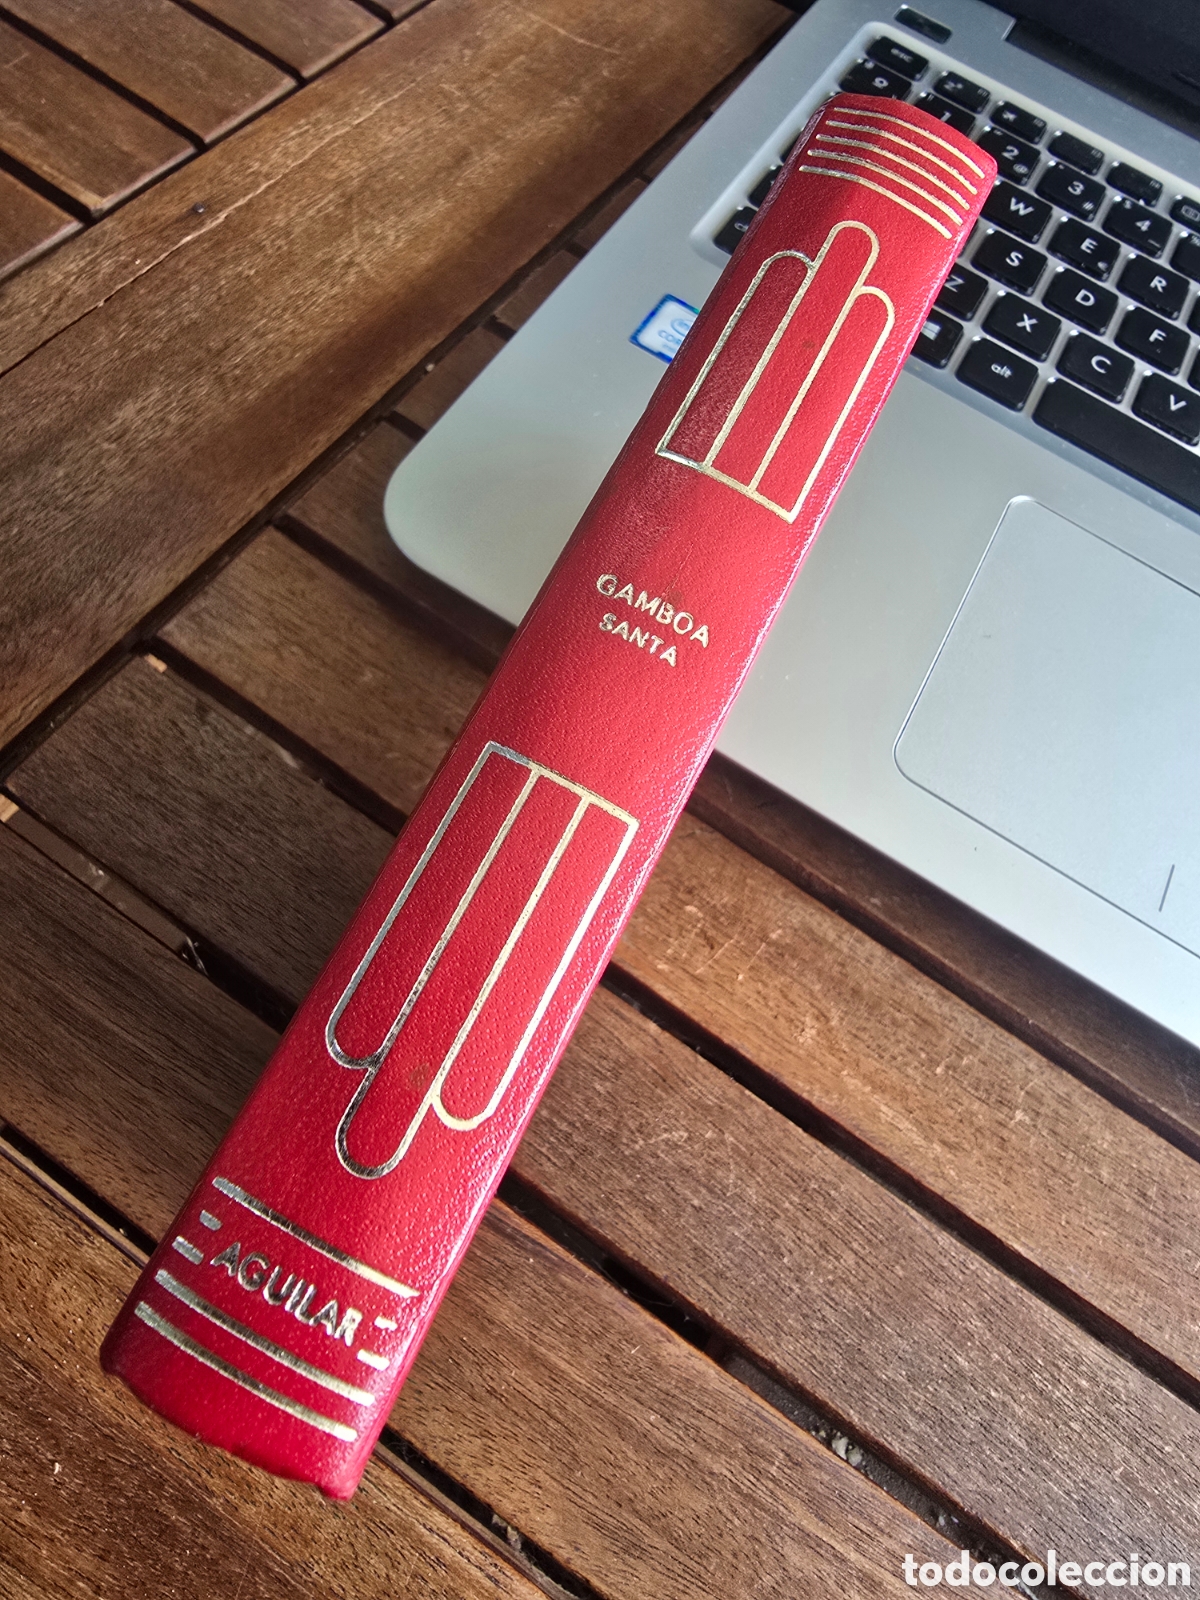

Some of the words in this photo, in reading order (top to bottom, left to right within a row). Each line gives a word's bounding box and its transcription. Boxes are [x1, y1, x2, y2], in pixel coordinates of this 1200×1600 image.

[1001, 145, 1019, 160] 2
[1067, 181, 1085, 196] 3
[1009, 196, 1034, 216] W
[1135, 220, 1151, 232] 4
[1080, 238, 1098, 254] E
[1005, 251, 1024, 267] S
[943, 274, 966, 293] Z
[1150, 275, 1167, 293] R
[1075, 288, 1095, 307] D
[1016, 313, 1038, 333] X
[1149, 328, 1167, 342] F
[991, 363, 1013, 378] alt
[1091, 355, 1112, 374] C
[1169, 394, 1187, 412] V
[596, 573, 709, 648] GAMBOA
[599, 612, 677, 667] SANTA
[210, 1241, 362, 1347] AGUILAR
